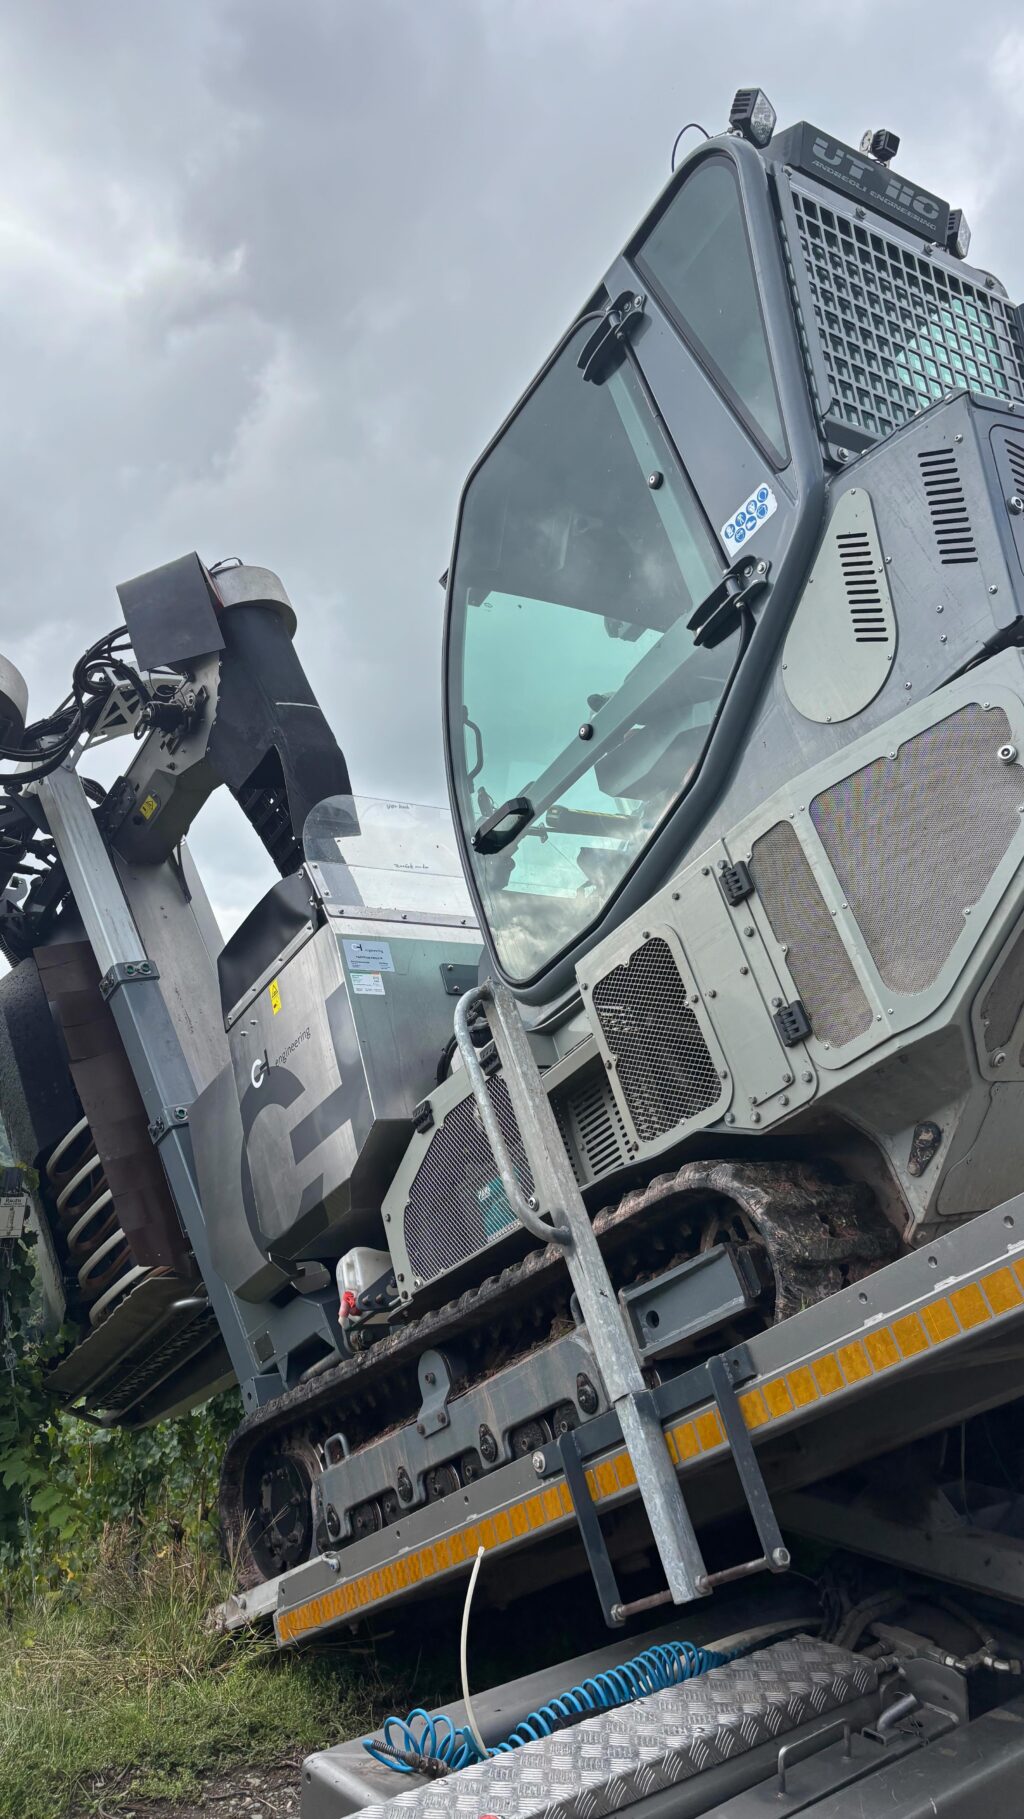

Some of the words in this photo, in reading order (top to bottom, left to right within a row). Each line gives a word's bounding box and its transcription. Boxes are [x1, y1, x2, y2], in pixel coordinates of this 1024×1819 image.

[812, 137, 875, 180] UT
[811, 160, 868, 193] ANDREOLI
[869, 190, 937, 231] ENGINEERING
[275, 1026, 311, 1067] engineering
